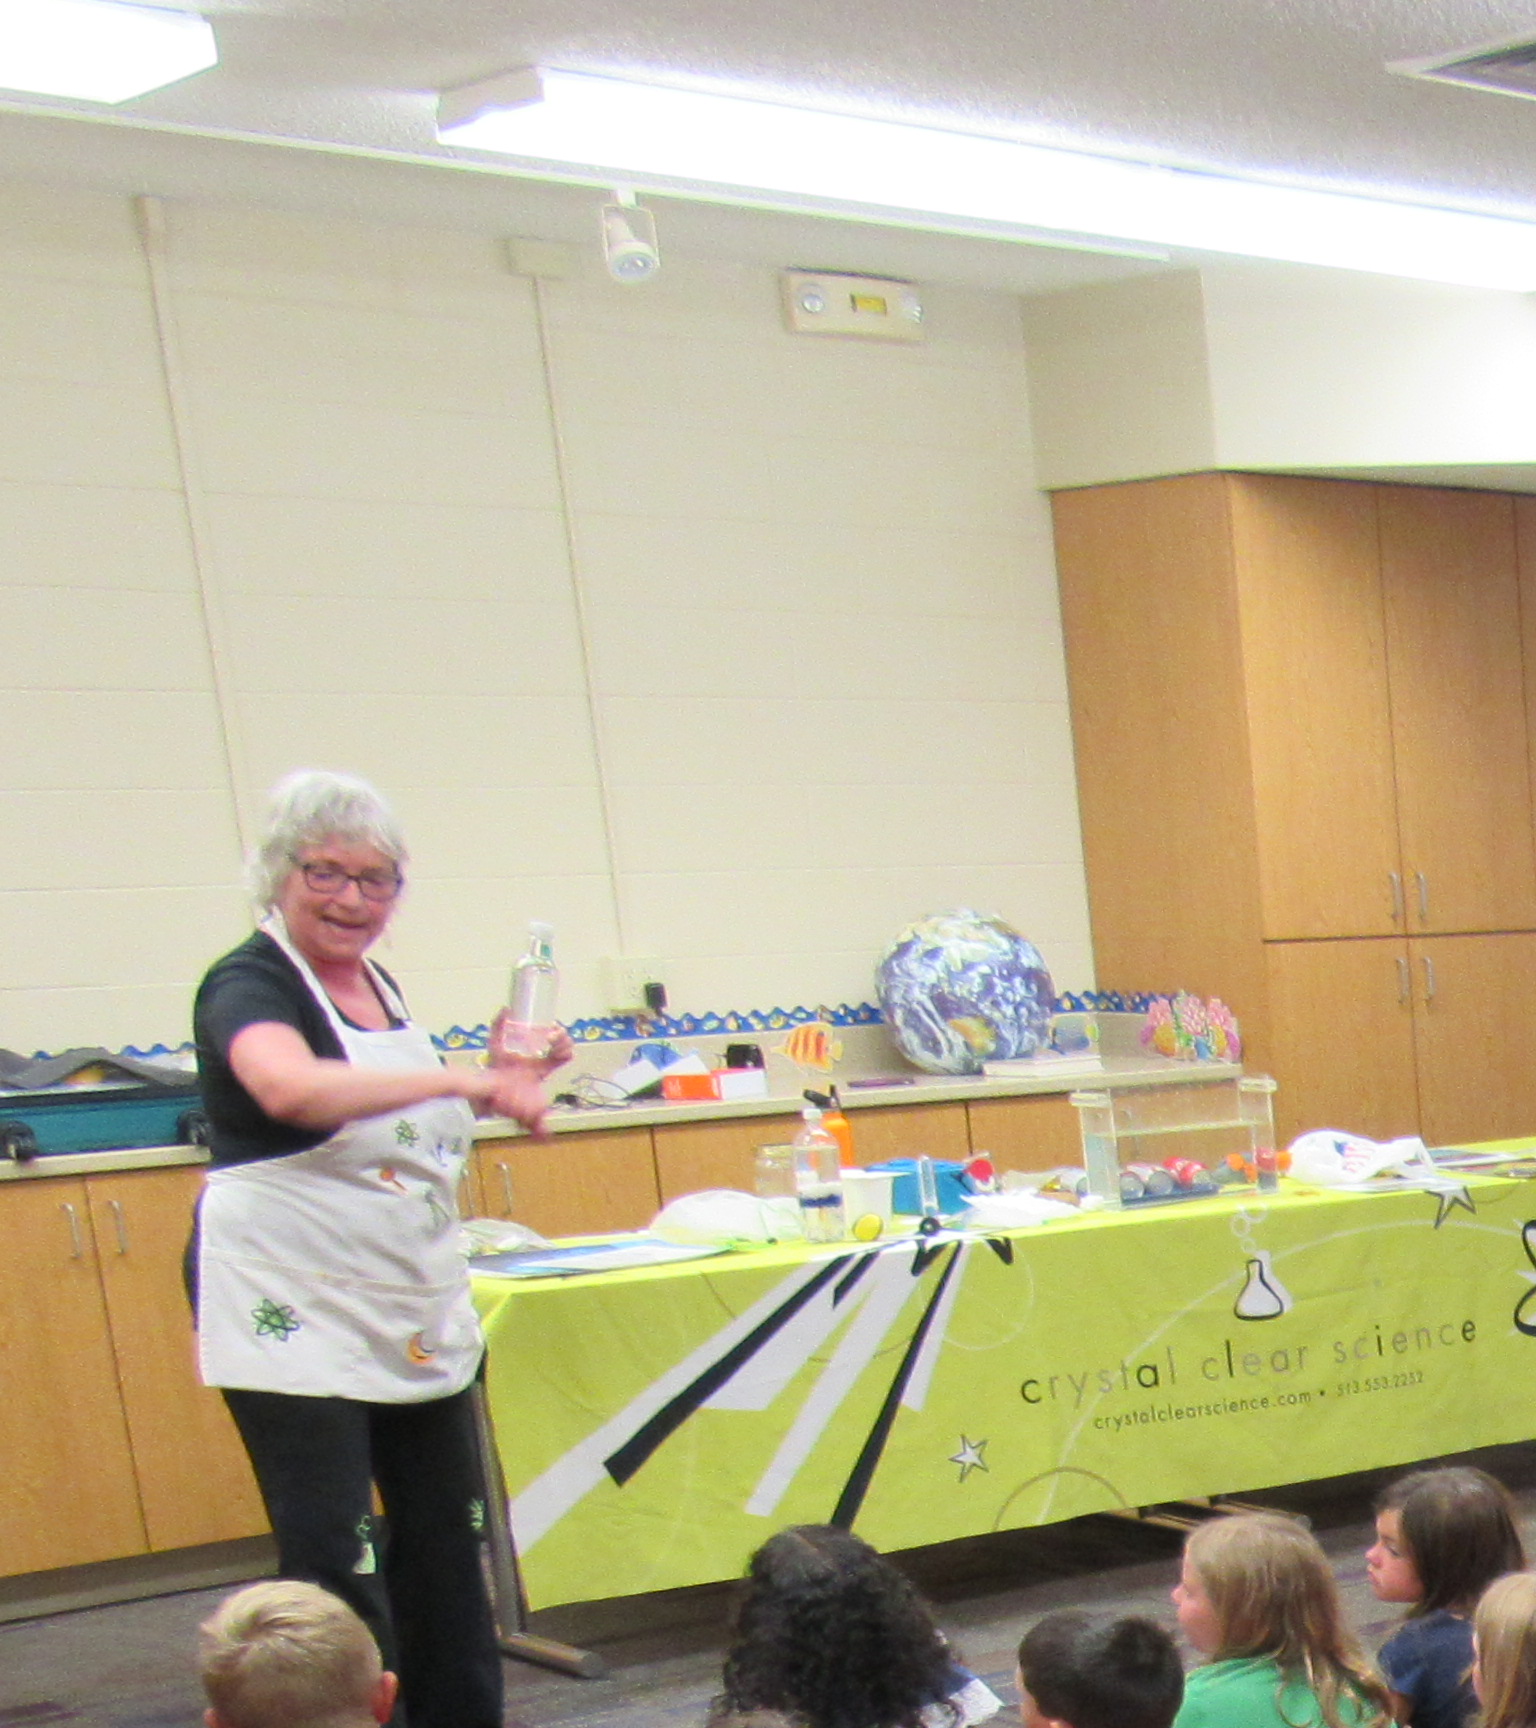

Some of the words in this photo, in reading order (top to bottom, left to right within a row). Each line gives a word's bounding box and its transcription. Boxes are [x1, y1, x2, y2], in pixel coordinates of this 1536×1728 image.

[1020, 1345, 1177, 1410] crystal
[1201, 1339, 1309, 1384] clear
[1333, 1317, 1478, 1365] science
[1094, 1389, 1312, 1433] crystalclearscience.com
[1336, 1370, 1425, 1398] 513.553.2252
